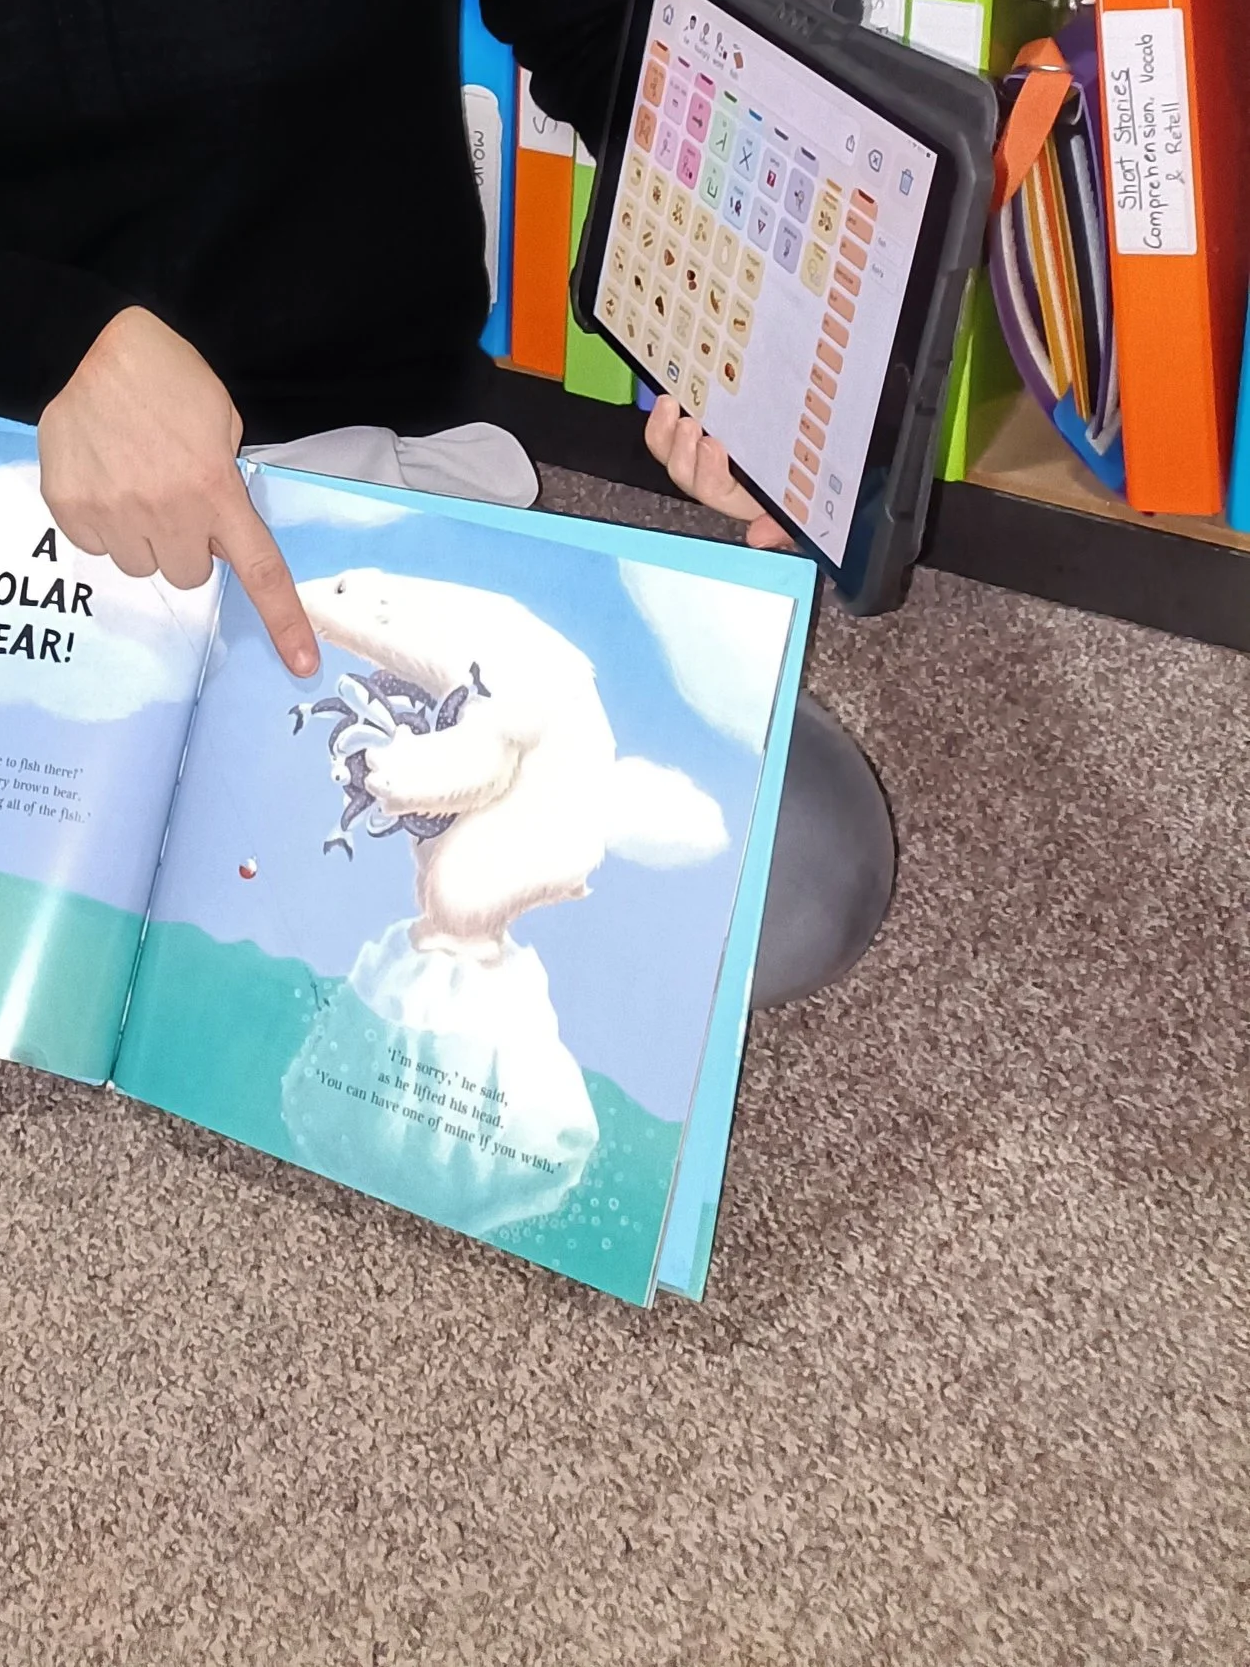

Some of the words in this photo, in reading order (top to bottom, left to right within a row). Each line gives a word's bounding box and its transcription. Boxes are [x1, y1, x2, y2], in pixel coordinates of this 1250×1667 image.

[1135, 34, 1154, 83] Vocab
[1111, 68, 1132, 145] Stories
[1161, 101, 1183, 154] Retell
[1115, 156, 1137, 210] Short
[1166, 170, 1185, 184] &
[32, 528, 57, 562] A
[6, 757, 17, 768] to
[18, 758, 40, 773] fish
[6, 799, 21, 811] all
[24, 802, 38, 816] of
[39, 805, 57, 817] the
[13, 778, 49, 795] brown
[53, 785, 82, 801] bear.
[377, 1072, 391, 1084] as
[395, 1075, 410, 1092] he
[413, 1082, 446, 1107] lifted
[450, 1094, 468, 1115] his
[471, 1105, 505, 1130] head.
[461, 1077, 476, 1094] he
[480, 1084, 509, 1107] said,
[346, 1084, 367, 1101] can
[370, 1089, 399, 1113] have
[402, 1105, 424, 1123] one
[427, 1115, 443, 1133] of
[444, 1121, 476, 1144] mine
[478, 1133, 492, 1153] if
[492, 1141, 516, 1161] you
